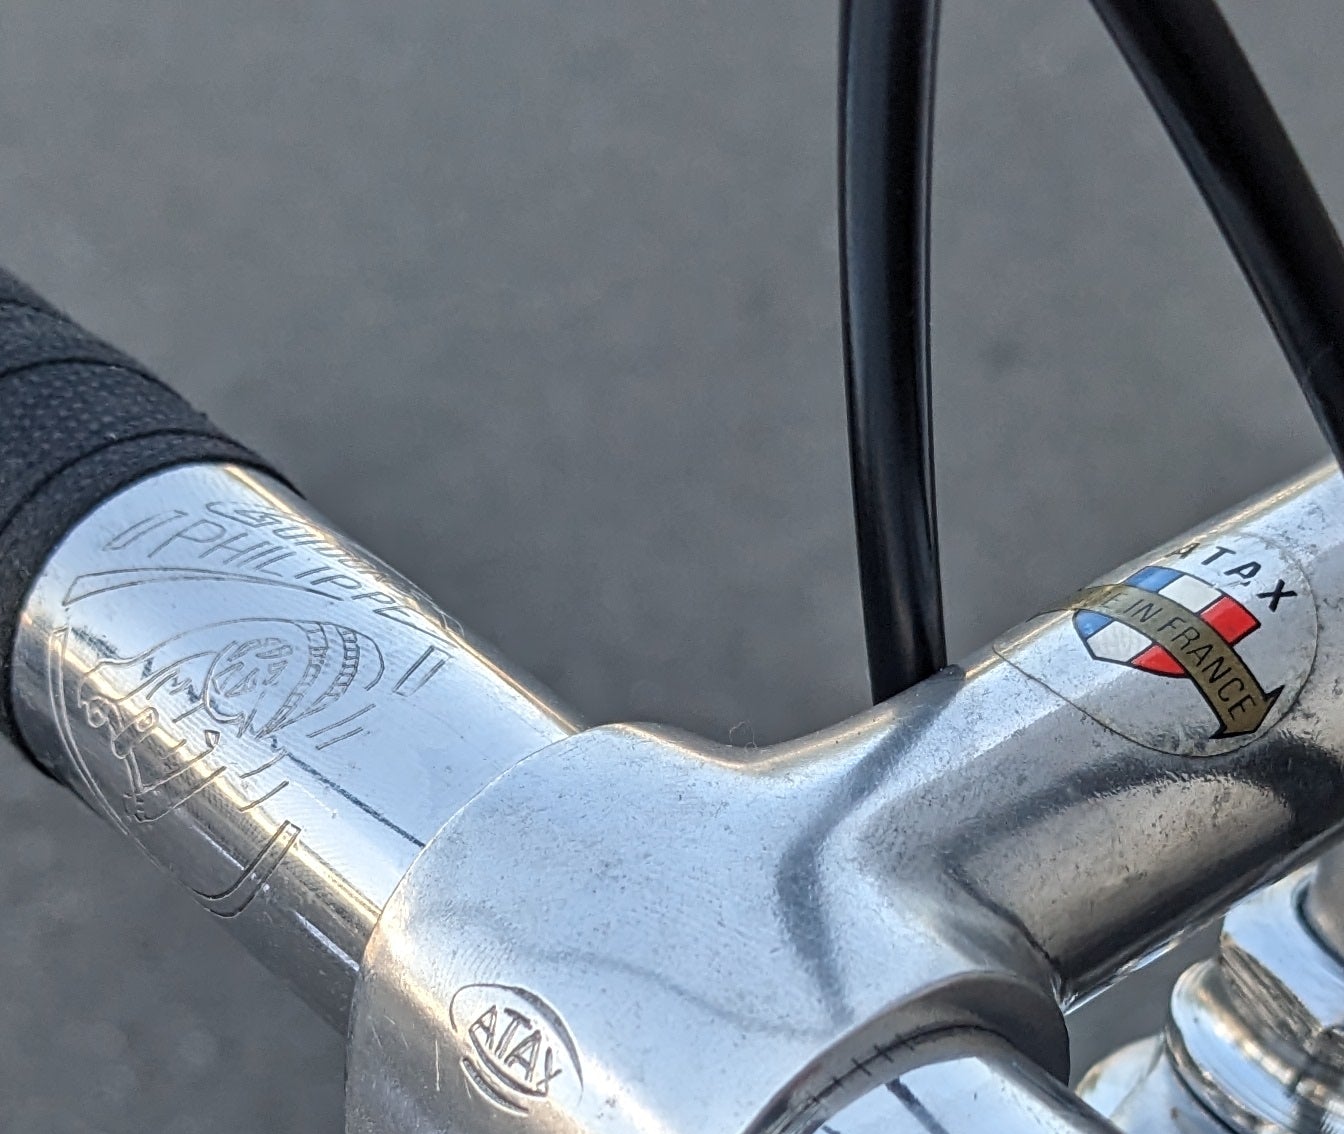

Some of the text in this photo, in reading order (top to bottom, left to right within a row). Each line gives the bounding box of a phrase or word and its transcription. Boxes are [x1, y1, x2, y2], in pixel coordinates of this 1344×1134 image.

[1165, 541, 1299, 613] ATAX
[1129, 597, 1257, 721] IN FRANCE
[469, 1005, 562, 1096] ATAX
